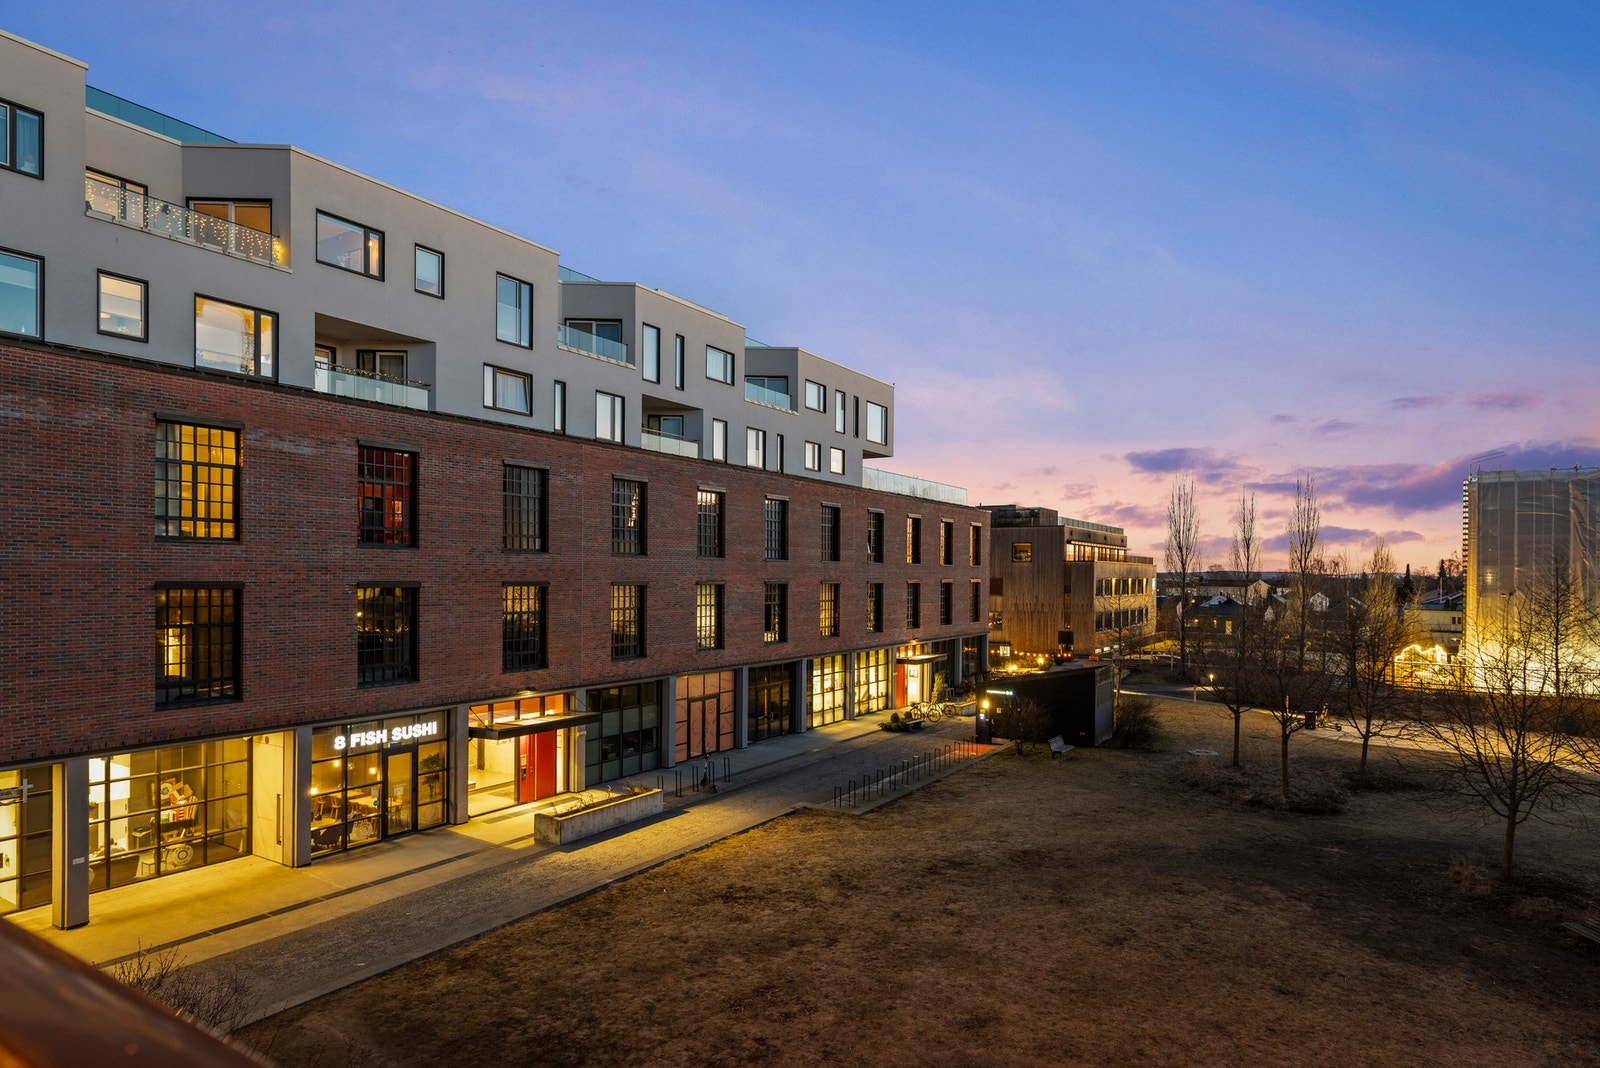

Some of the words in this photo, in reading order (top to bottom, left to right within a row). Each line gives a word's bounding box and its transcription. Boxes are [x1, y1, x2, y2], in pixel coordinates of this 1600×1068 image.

[334, 736, 346, 750] 8
[350, 729, 387, 748] FISH
[391, 721, 438, 741] SUSHI
